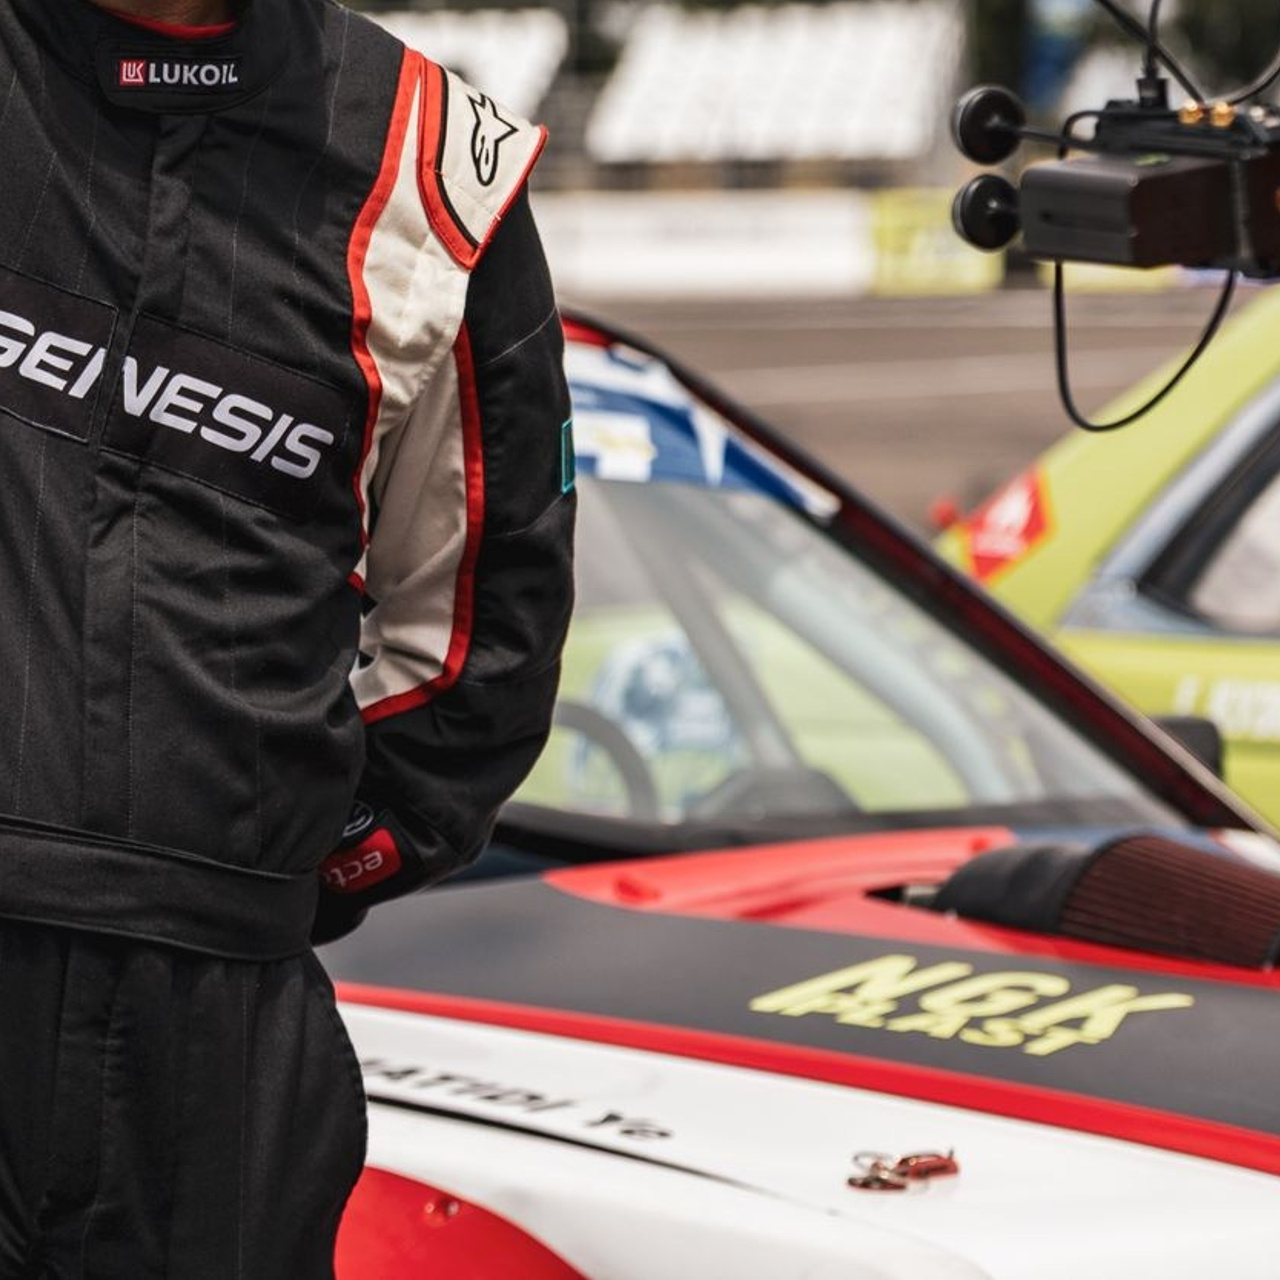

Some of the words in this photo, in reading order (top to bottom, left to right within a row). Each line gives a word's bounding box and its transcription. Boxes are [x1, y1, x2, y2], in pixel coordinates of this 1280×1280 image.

[148, 63, 238, 85] LUKOIL
[322, 850, 383, 888] ect
[750, 954, 1195, 1039] NGK
